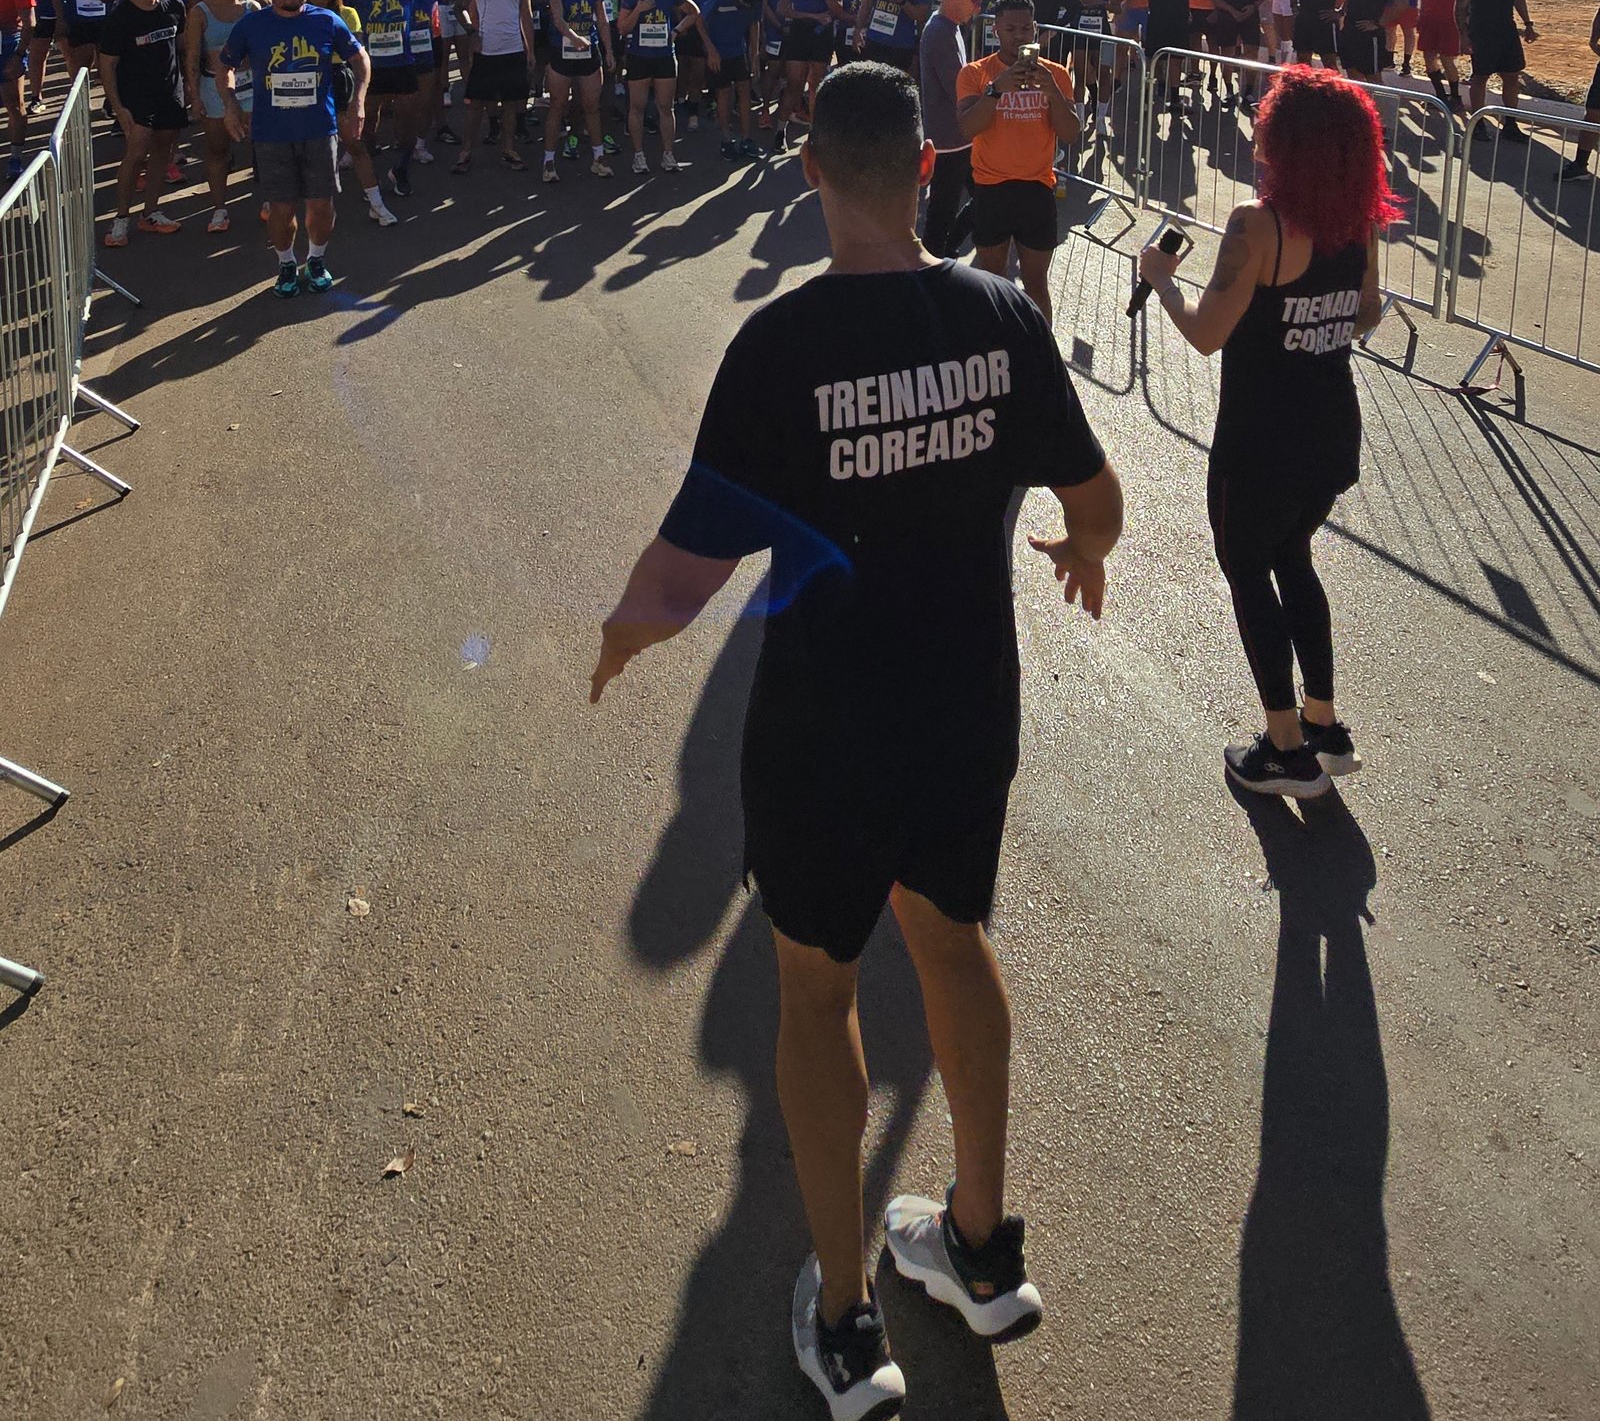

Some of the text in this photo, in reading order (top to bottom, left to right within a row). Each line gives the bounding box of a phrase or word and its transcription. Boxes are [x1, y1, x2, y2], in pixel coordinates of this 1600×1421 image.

[366, 22, 386, 34] RUN
[1003, 111, 1042, 120] fit mania
[1282, 290, 1361, 324] TREINAD
[814, 349, 1011, 432] TREINADOR
[830, 408, 996, 480] COREABS
